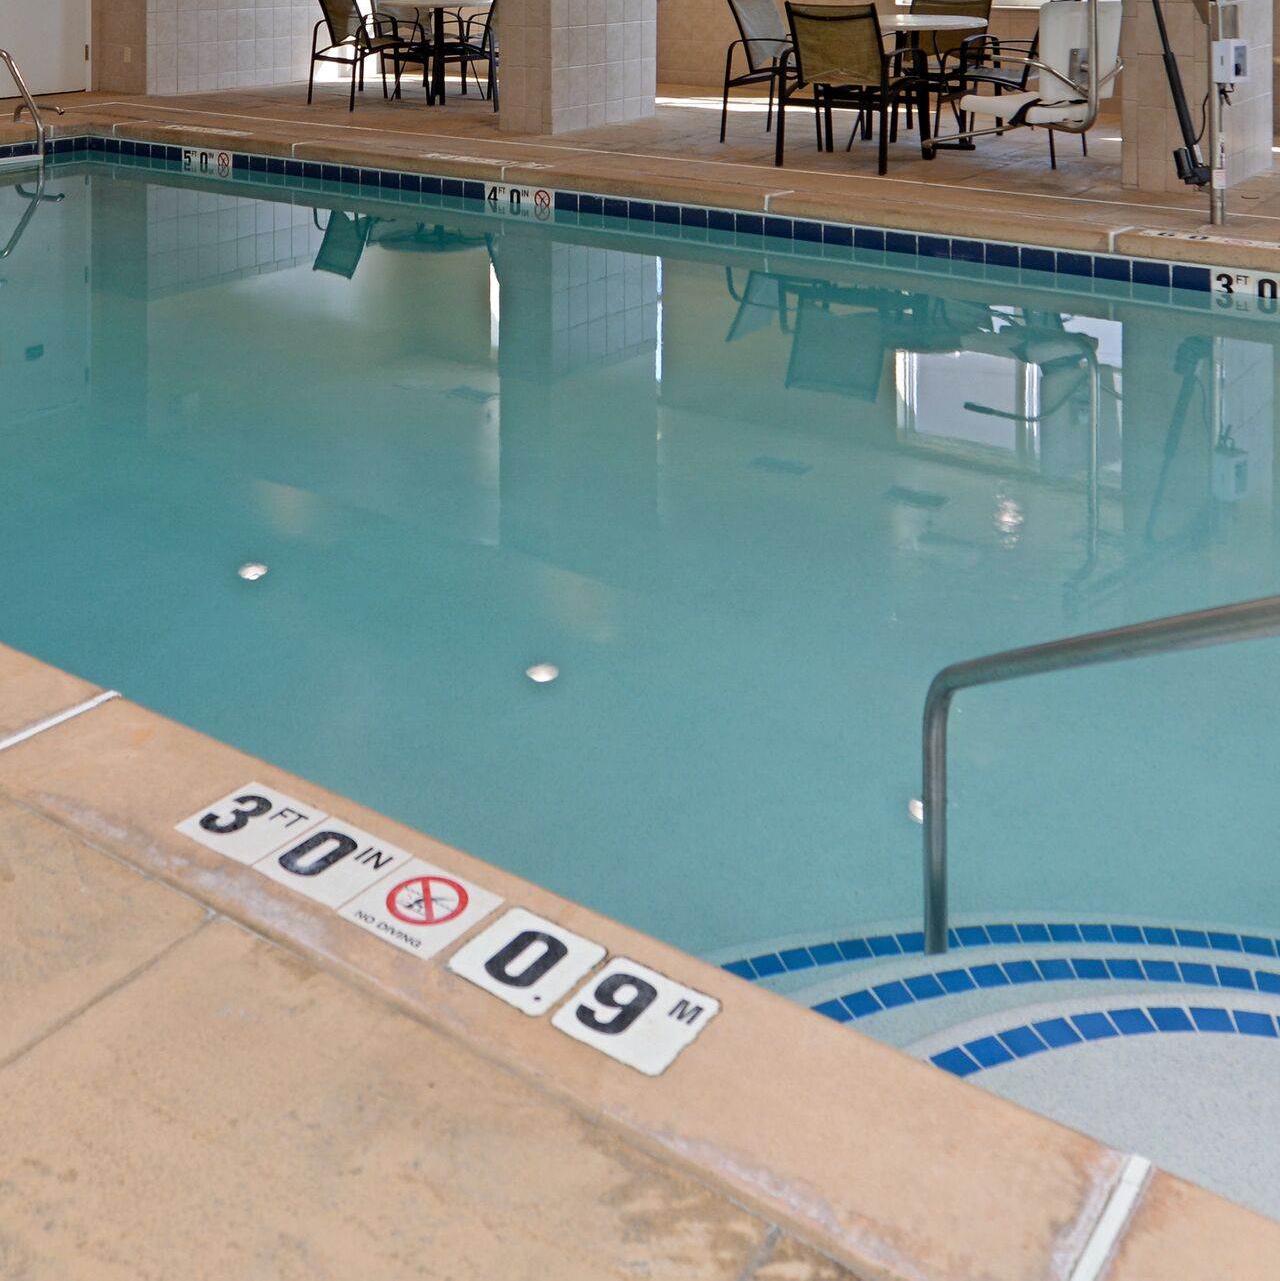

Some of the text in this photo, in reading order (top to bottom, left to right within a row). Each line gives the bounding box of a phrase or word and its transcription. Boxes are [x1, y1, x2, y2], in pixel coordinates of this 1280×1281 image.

[183, 150, 192, 163] 5
[487, 186, 498, 201] 4
[498, 186, 506, 195] FT
[521, 189, 529, 198] IN
[1216, 273, 1234, 293] 3
[1236, 274, 1250, 286] FT
[198, 794, 395, 878] 3 FT 0 IN
[354, 910, 423, 949] NO DIVING
[668, 998, 705, 1026] M
